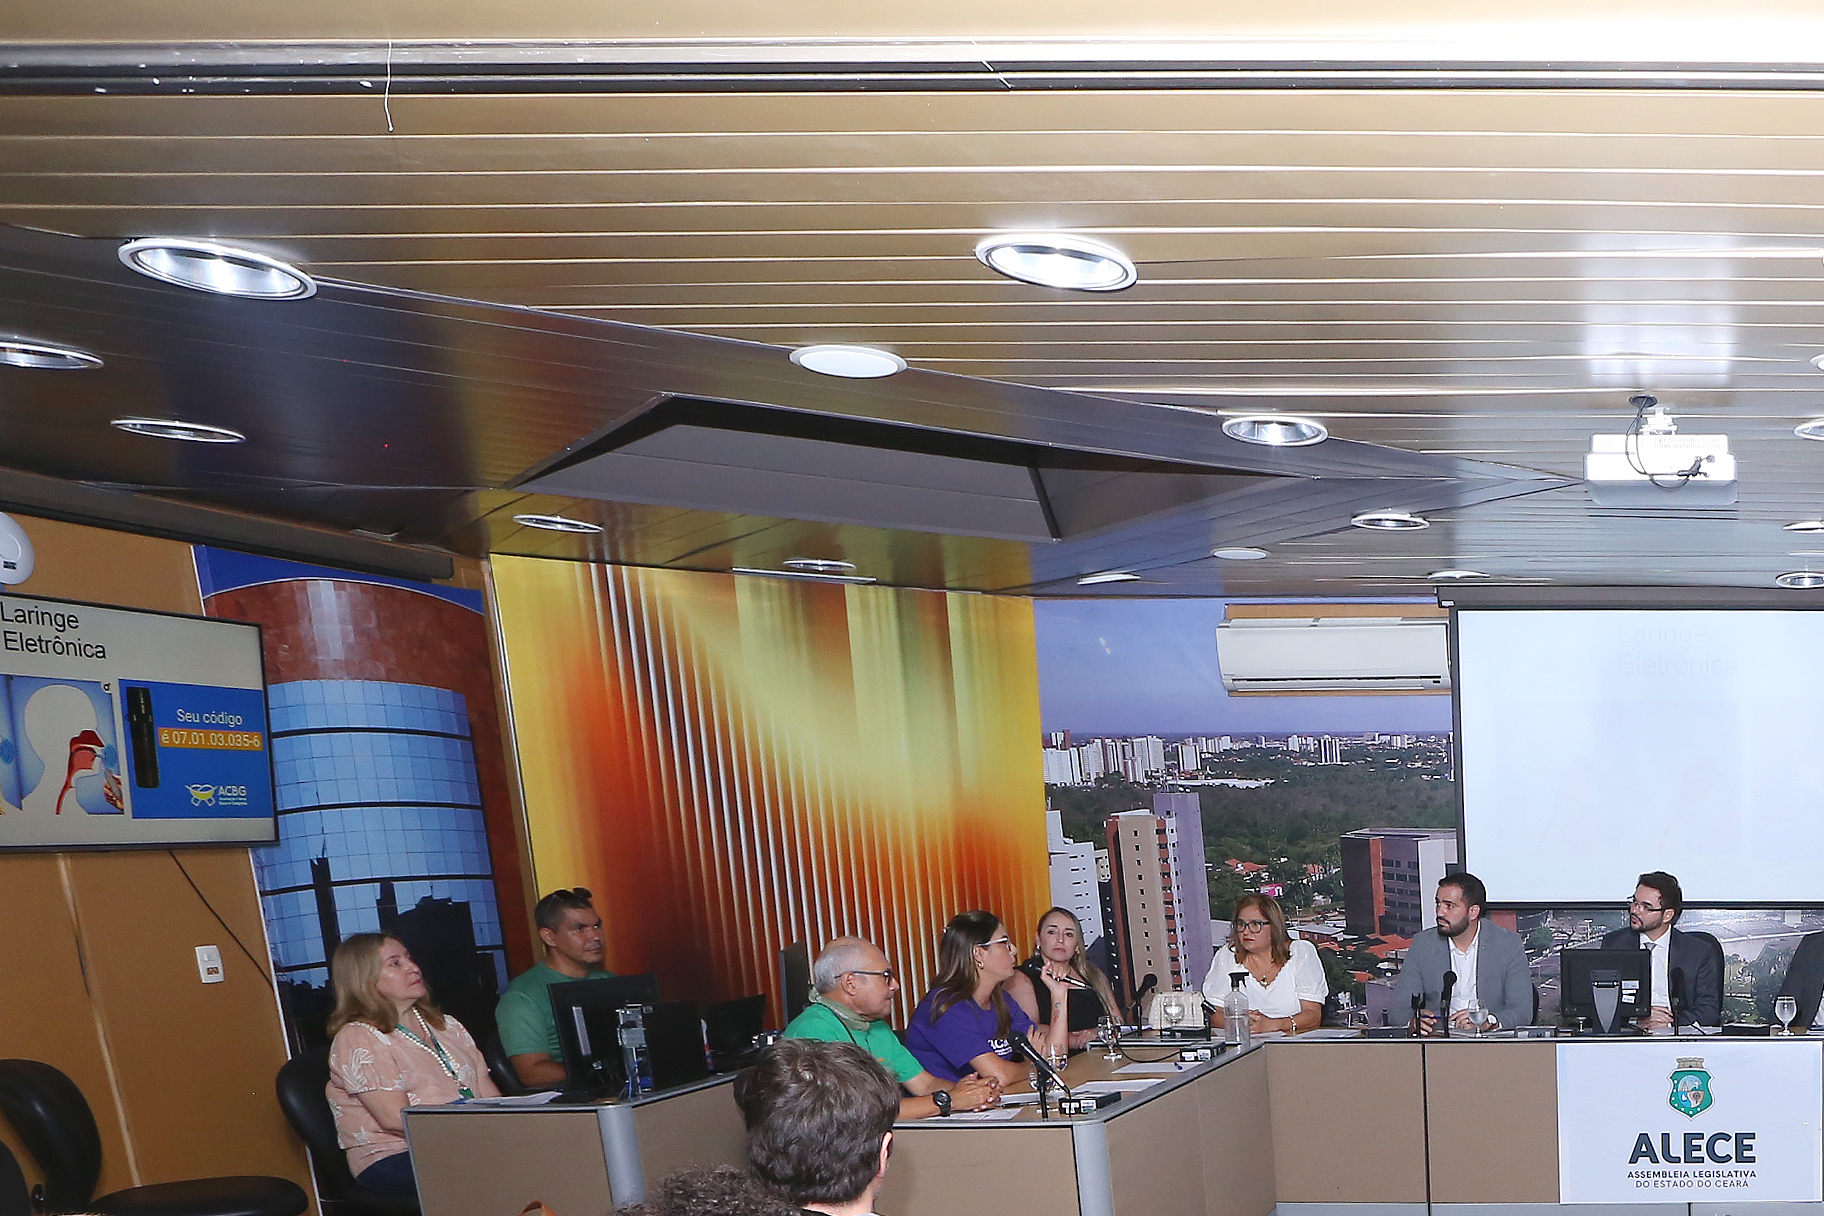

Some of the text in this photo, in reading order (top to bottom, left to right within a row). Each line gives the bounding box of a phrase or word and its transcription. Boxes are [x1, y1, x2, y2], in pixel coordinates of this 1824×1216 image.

[0, 601, 79, 632] Laringe
[3, 630, 106, 659] Eletrônica
[176, 708, 243, 728] Seu código
[161, 730, 261, 748] é 07.01.03.035-6
[218, 785, 247, 796] ACBG
[1628, 1132, 1756, 1164] ALECE
[1627, 1170, 1756, 1178] ASSEMBLEIA LEGISLATIVA
[1635, 1180, 1650, 1188] DO
[1653, 1180, 1694, 1188] ESTADO
[1697, 1180, 1712, 1188] DO
